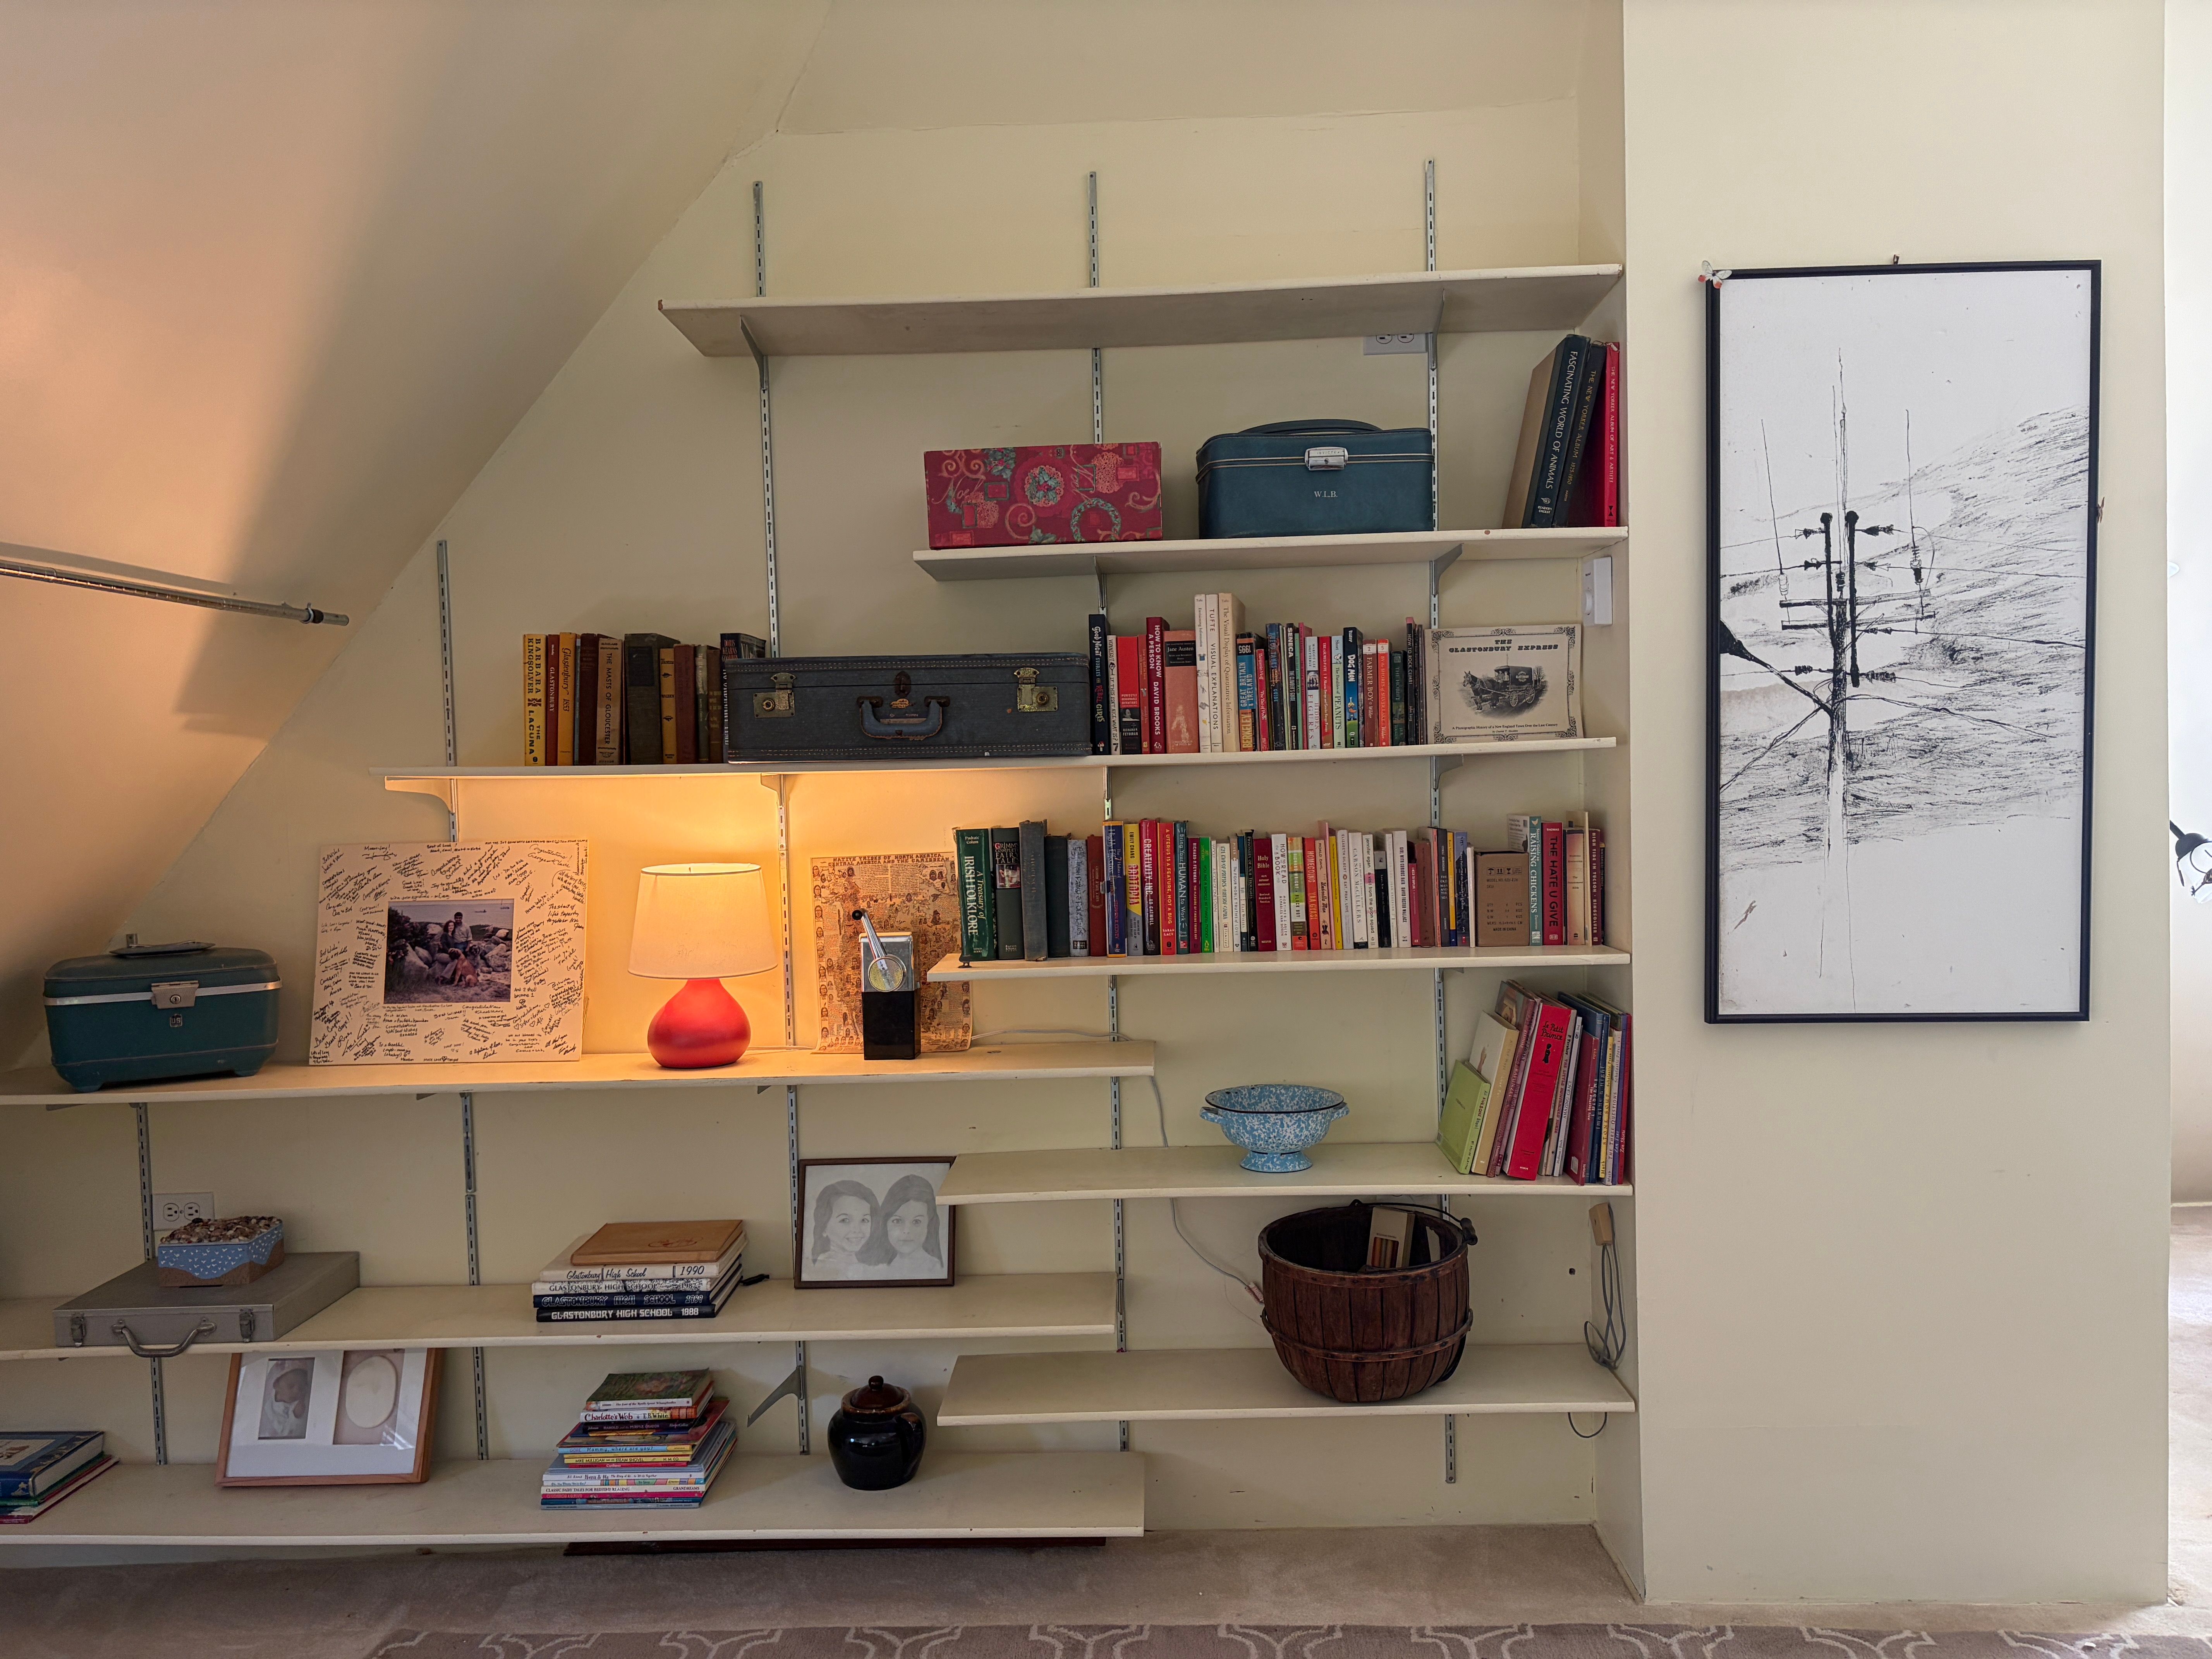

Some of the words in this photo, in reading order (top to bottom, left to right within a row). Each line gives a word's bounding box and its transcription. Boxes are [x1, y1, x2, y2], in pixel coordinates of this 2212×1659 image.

[1561, 351, 1578, 404] FASCINATING
[1555, 408, 1567, 438] WORLD
[1578, 405, 1589, 431] YORKER
[1552, 441, 1561, 452] OF
[1572, 433, 1582, 458] ALBUM
[1545, 454, 1558, 489] ANIMALS
[1155, 644, 1161, 653] TO
[1238, 645, 1251, 653] 1995
[606, 692, 611, 701] OF
[1241, 714, 1251, 748] BERKELEY
[1549, 836, 1558, 856] THE
[964, 856, 975, 882] IRISH
[1144, 839, 1152, 881] CREATIVITY,
[1307, 851, 1315, 883] HOMEGOING
[1128, 864, 1140, 905] BROTOPIA
[966, 884, 978, 935] FOLKLORE
[1549, 902, 1558, 926] GIVE
[1541, 1028, 1563, 1040] Prince
[1551, 1023, 1564, 1033] Petit
[567, 1269, 601, 1279] Glastonbury
[606, 1269, 621, 1279] High
[626, 1267, 647, 1278] School
[680, 1266, 704, 1275] 1990
[549, 1283, 601, 1291] GLASTONBURY
[542, 1297, 608, 1307] GLASTONBURY
[613, 1296, 636, 1305] HIGH
[644, 1295, 676, 1304] SCHOOL
[551, 1310, 613, 1320] GLASTONBURY
[681, 1308, 699, 1316] 1988
[584, 1413, 618, 1421] Charlotte's
